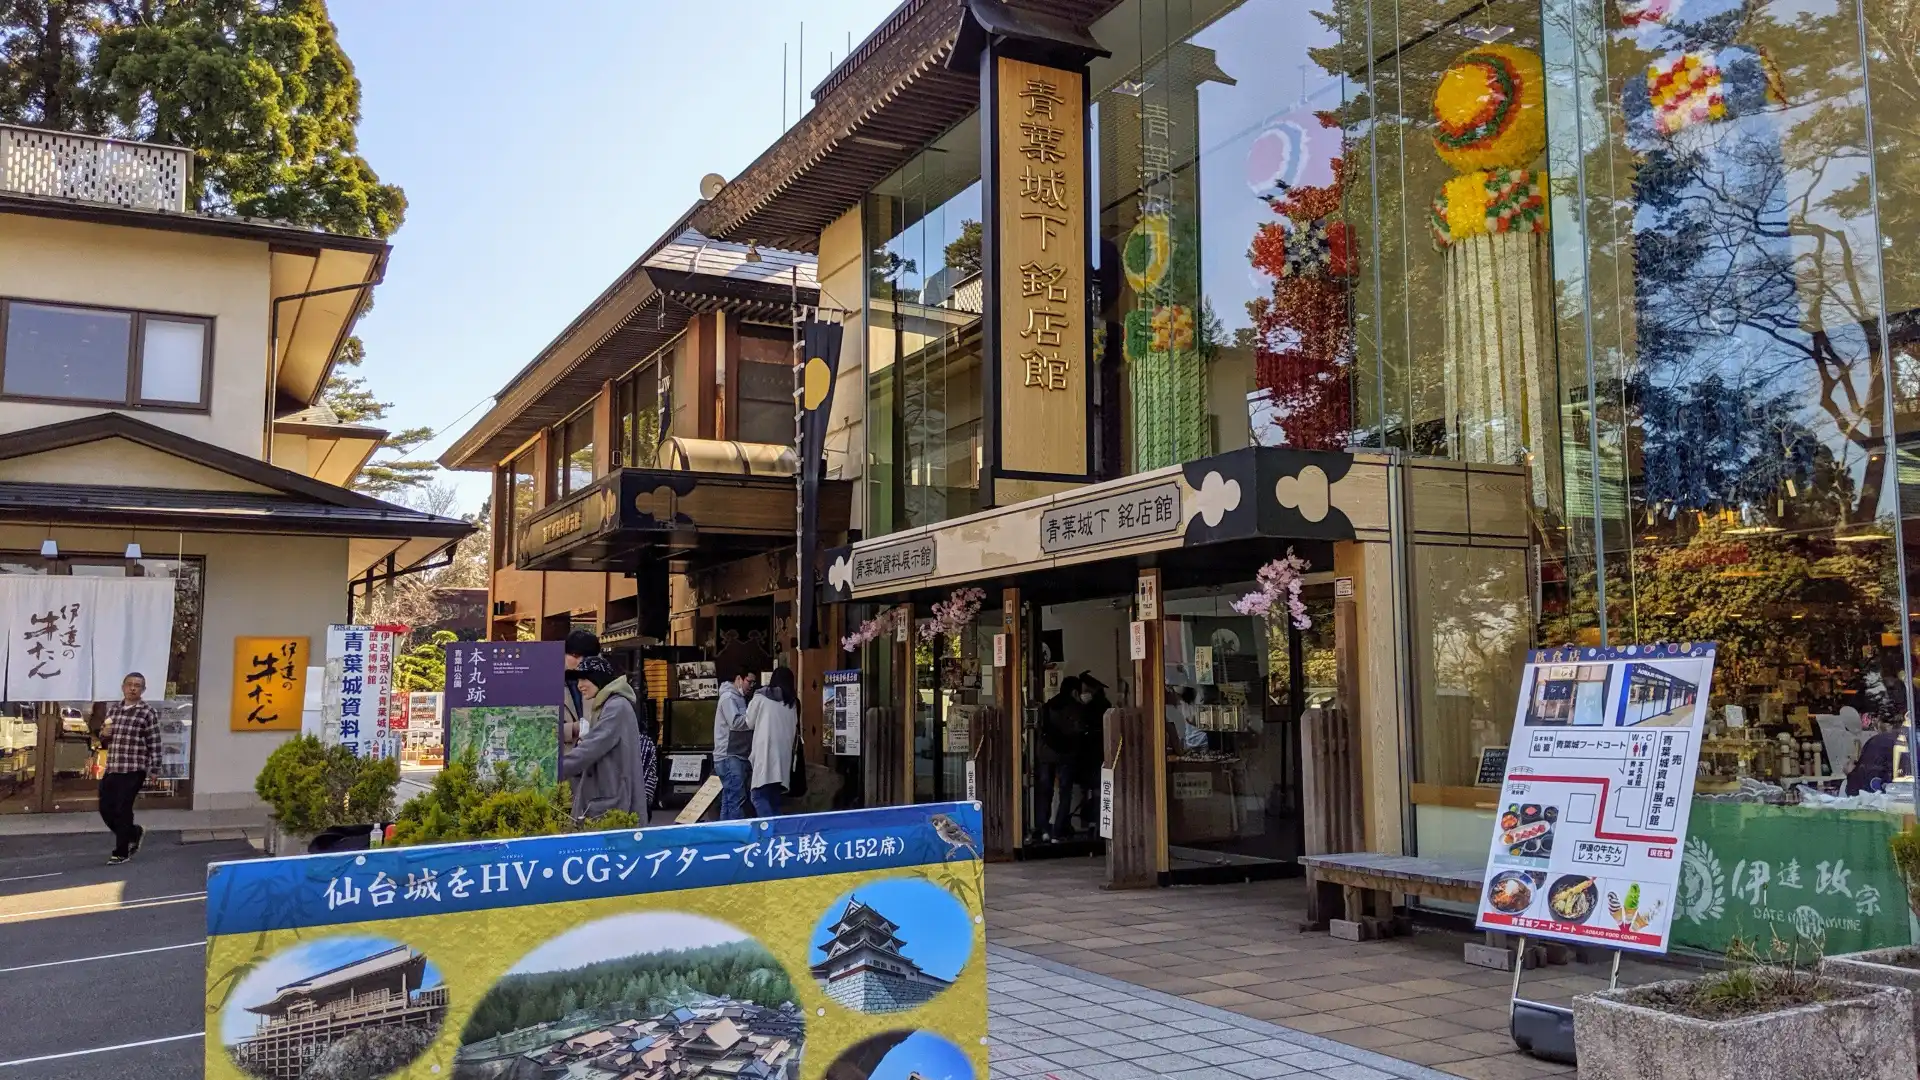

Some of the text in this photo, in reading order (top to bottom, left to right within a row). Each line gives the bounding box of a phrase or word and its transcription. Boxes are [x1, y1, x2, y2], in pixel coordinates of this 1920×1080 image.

[855, 547, 933, 580] 青葉城資料展示館
[24, 611, 61, 679] 牛たん
[367, 632, 378, 684] 歴史博物館
[246, 652, 279, 724] 牛たん
[376, 632, 390, 739] 伊達政宗公と青葉城の
[453, 649, 462, 688] 青葉山公園
[466, 648, 487, 703] 本丸跡
[1556, 740, 1626, 750] 青葉城フードコート
[1649, 735, 1673, 826] 青葉城資料展示館
[1102, 780, 1112, 831] 営業中
[1578, 852, 1621, 863] レストラン
[1579, 843, 1622, 855] 伊達の牛たん
[1650, 848, 1671, 859] 現在地
[1511, 918, 1577, 934] 青葉城フードコート
[1753, 907, 1784, 922] DATE
